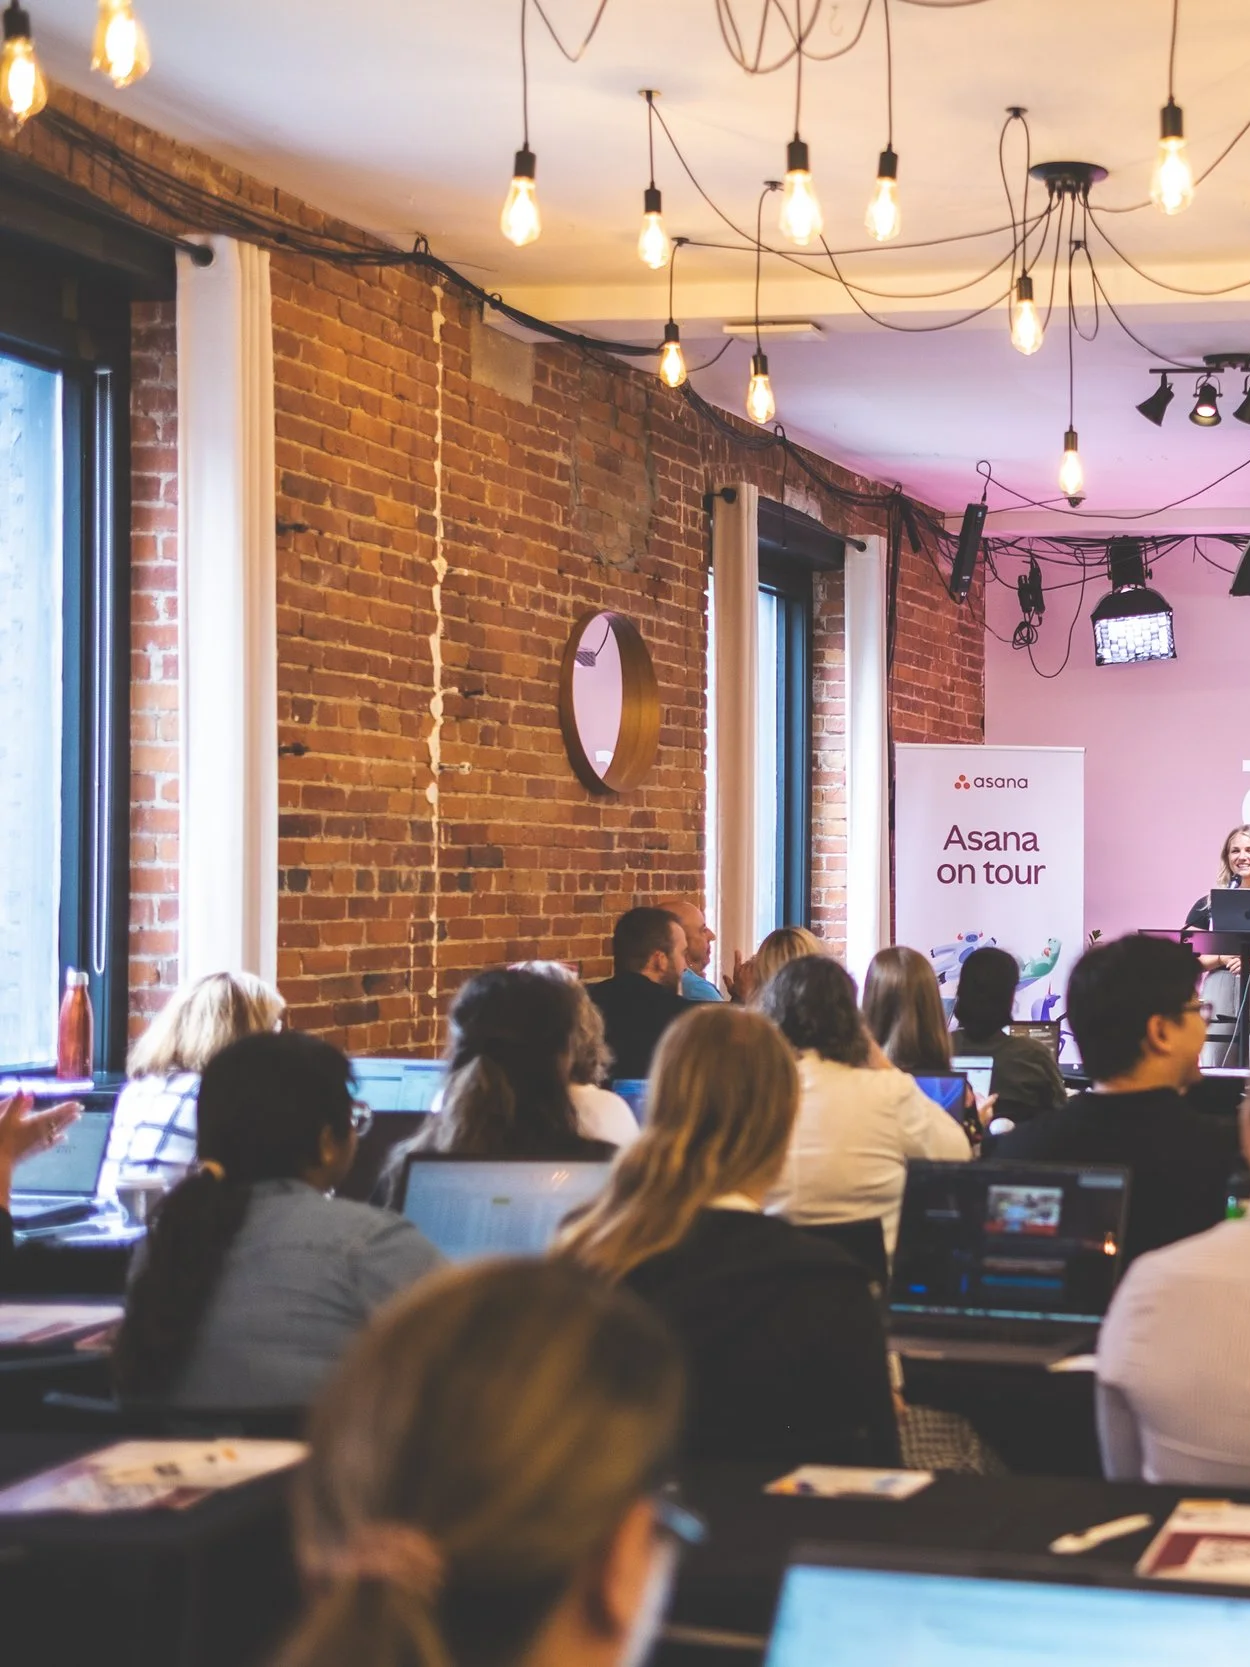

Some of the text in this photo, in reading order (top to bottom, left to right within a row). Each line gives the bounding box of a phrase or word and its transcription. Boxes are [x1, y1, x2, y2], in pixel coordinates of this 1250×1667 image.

[973, 777, 1028, 789] asana
[943, 824, 1040, 852] Asana
[936, 861, 1047, 885] on tour
